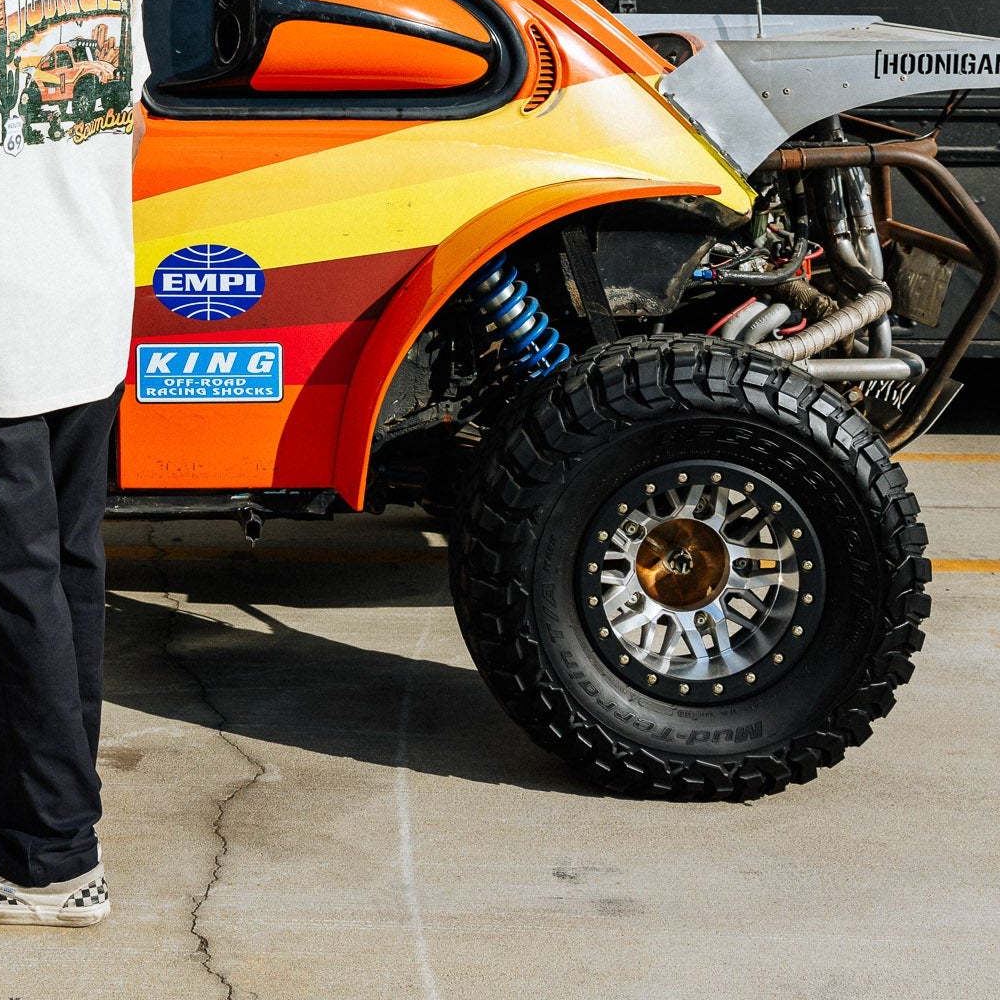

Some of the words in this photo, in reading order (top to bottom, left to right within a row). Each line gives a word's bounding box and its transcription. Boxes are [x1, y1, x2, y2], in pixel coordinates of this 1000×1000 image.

[7, 134, 22, 151] 69
[162, 273, 257, 292] EMPI
[145, 351, 276, 374] KING
[146, 387, 207, 396] RACING
[212, 387, 274, 396] SHOCKS
[164, 378, 247, 387] OFF-ROAD
[558, 649, 763, 746] Mud-Terrain
